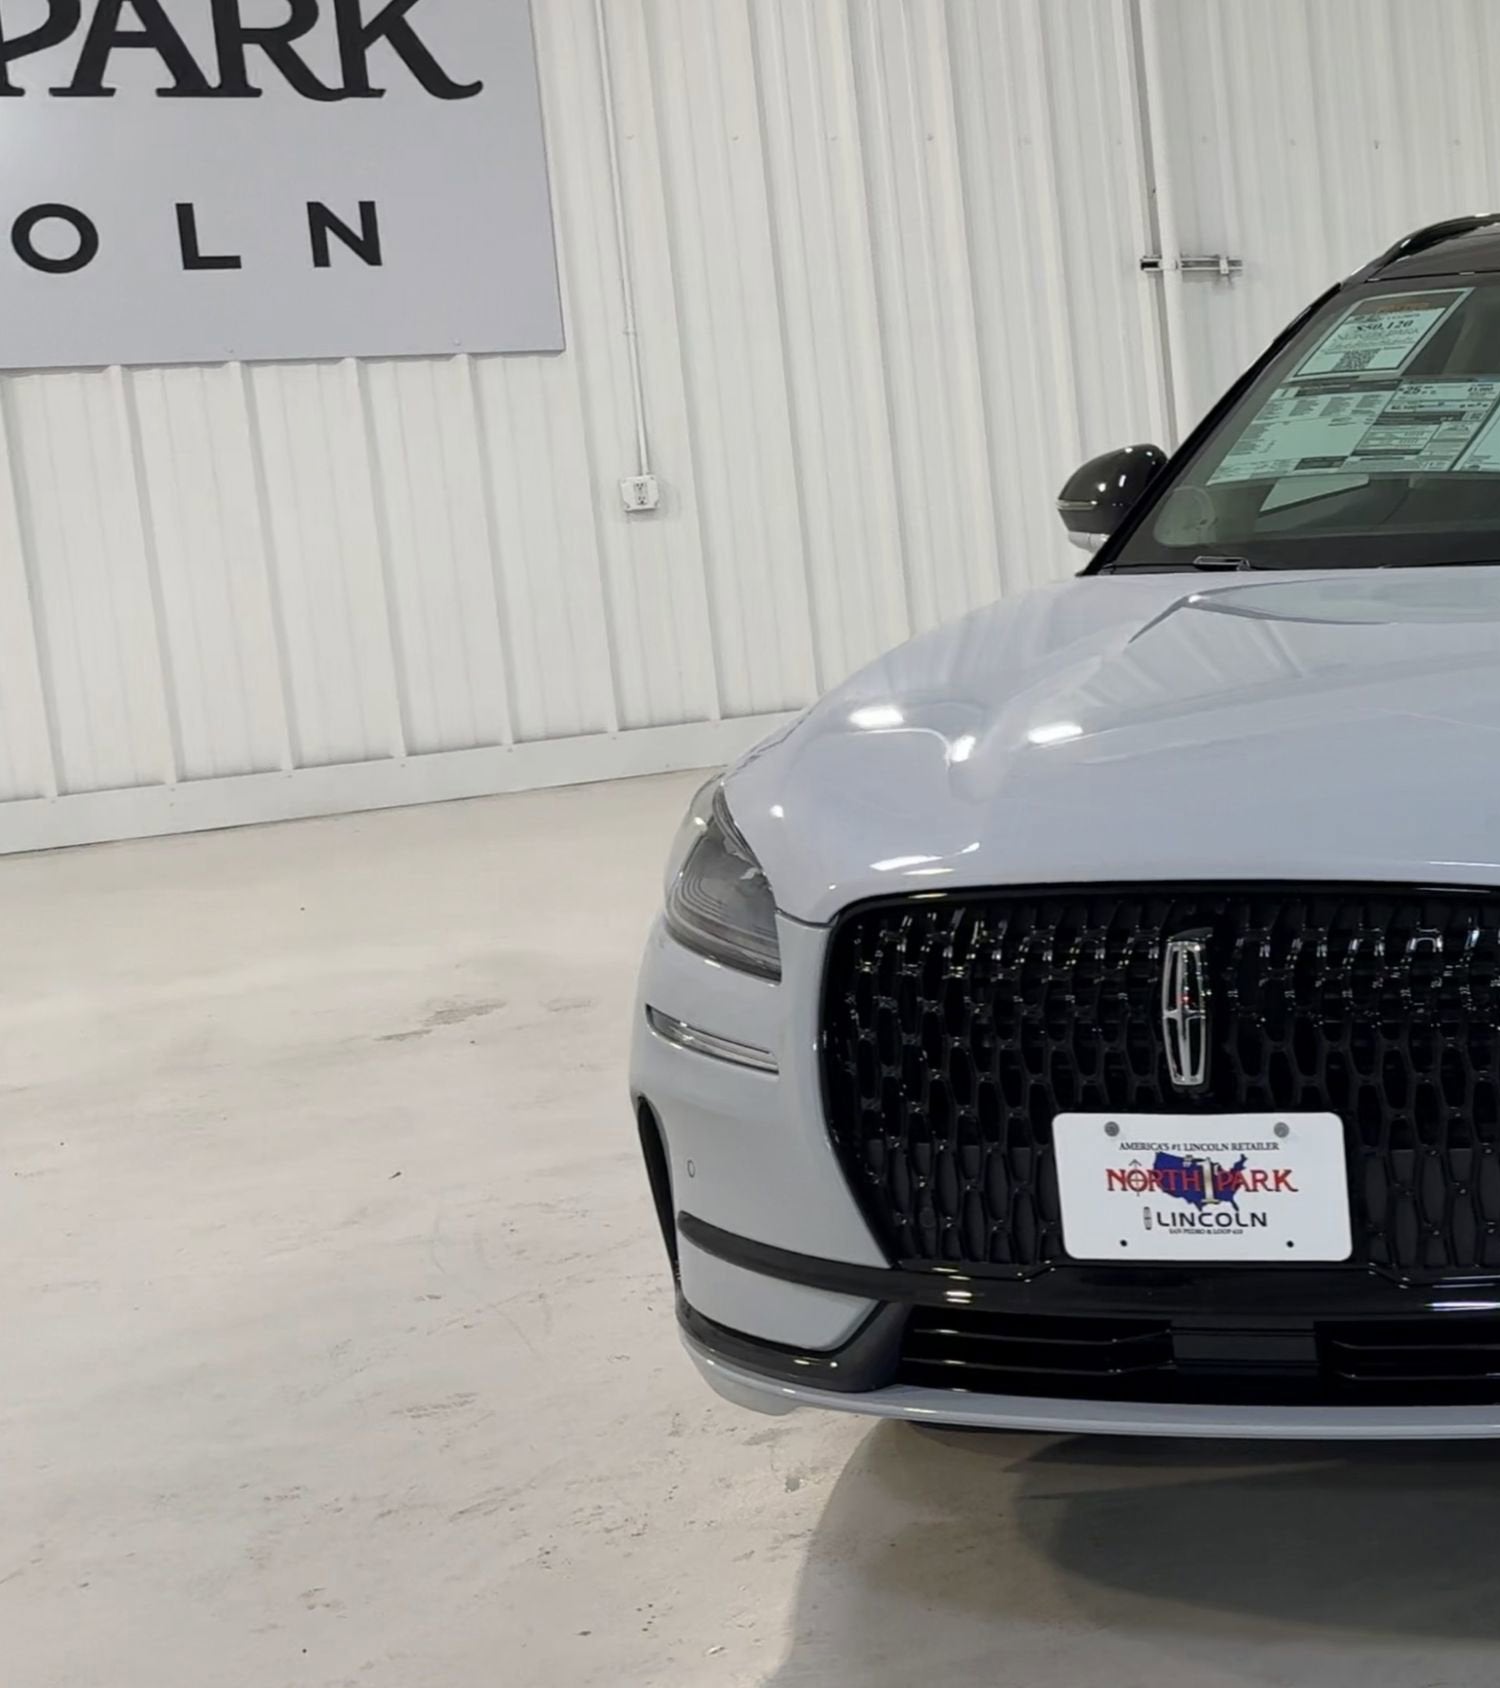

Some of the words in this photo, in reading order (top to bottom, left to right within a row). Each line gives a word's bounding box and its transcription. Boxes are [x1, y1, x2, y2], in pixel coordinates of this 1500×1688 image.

[1119, 1142, 1169, 1150] AMERICA'S
[1183, 1143, 1229, 1151] LINCOLN
[1231, 1142, 1280, 1150] RETAILER
[1105, 1168, 1201, 1192] NORTH
[1215, 1169, 1299, 1192] PARK
[1156, 1211, 1267, 1227] LINCOLN
